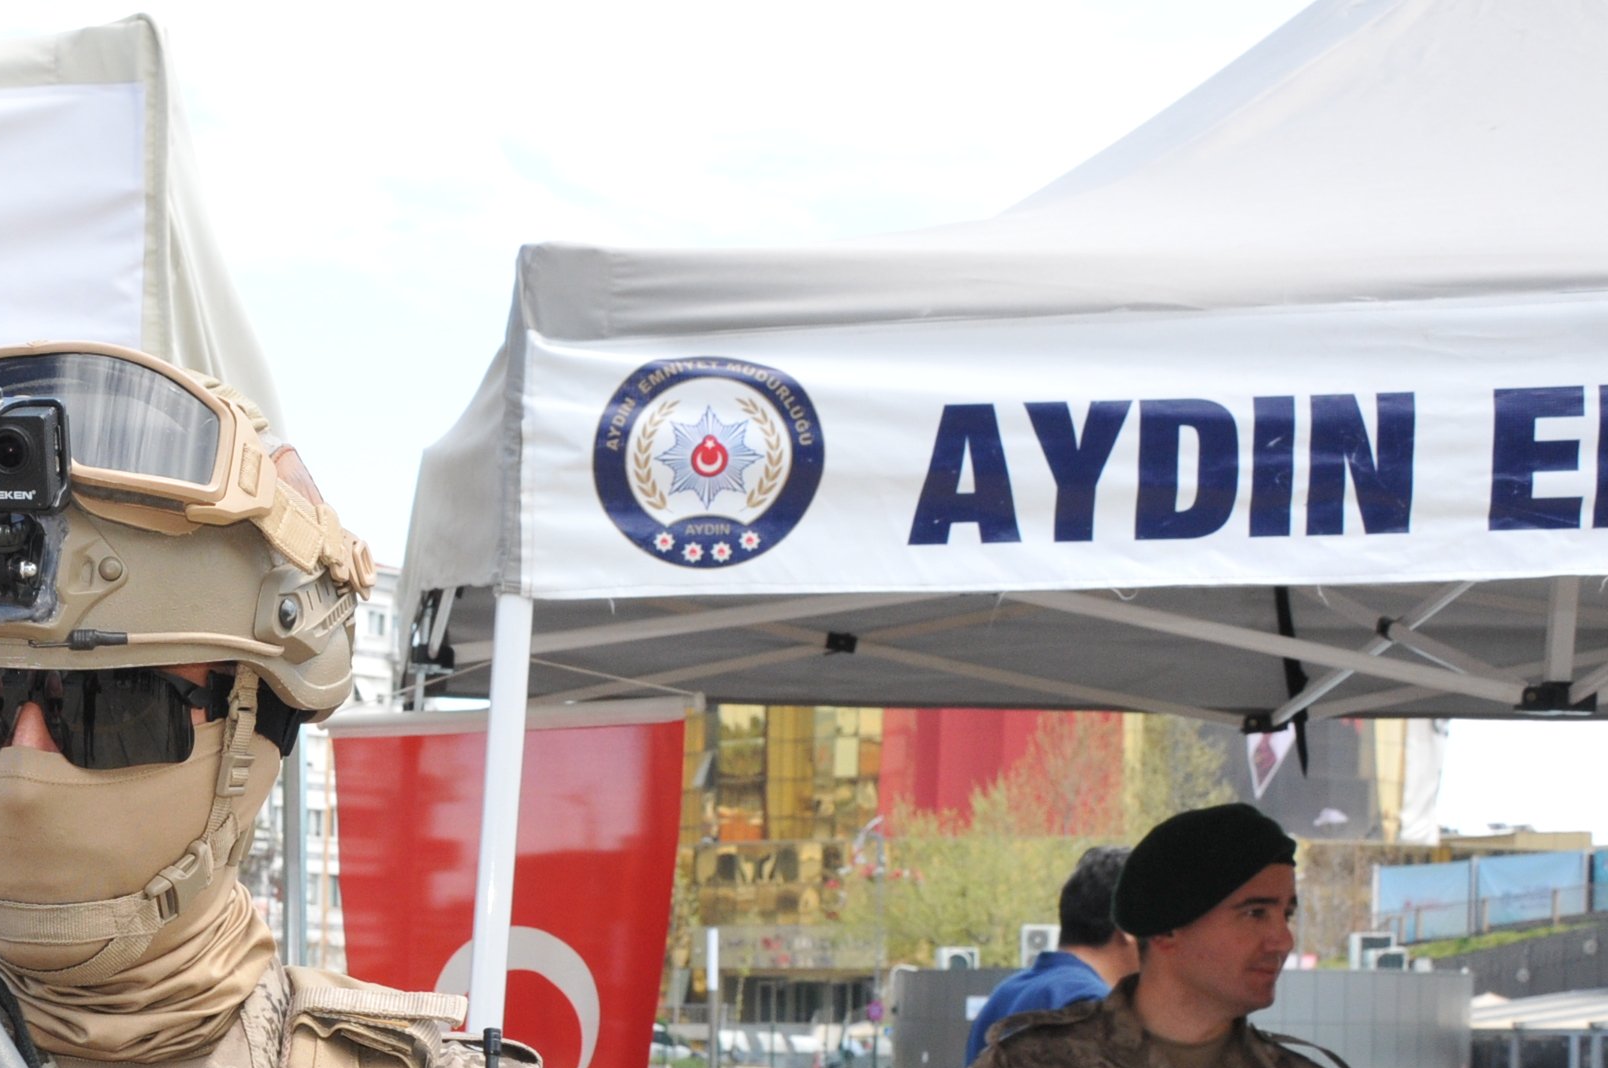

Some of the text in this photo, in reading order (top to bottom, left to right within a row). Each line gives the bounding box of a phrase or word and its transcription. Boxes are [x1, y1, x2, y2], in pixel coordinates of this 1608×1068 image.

[606, 397, 637, 451] AYDIN
[907, 384, 1608, 546] AYDIN E
[684, 524, 731, 536] AYDIN
